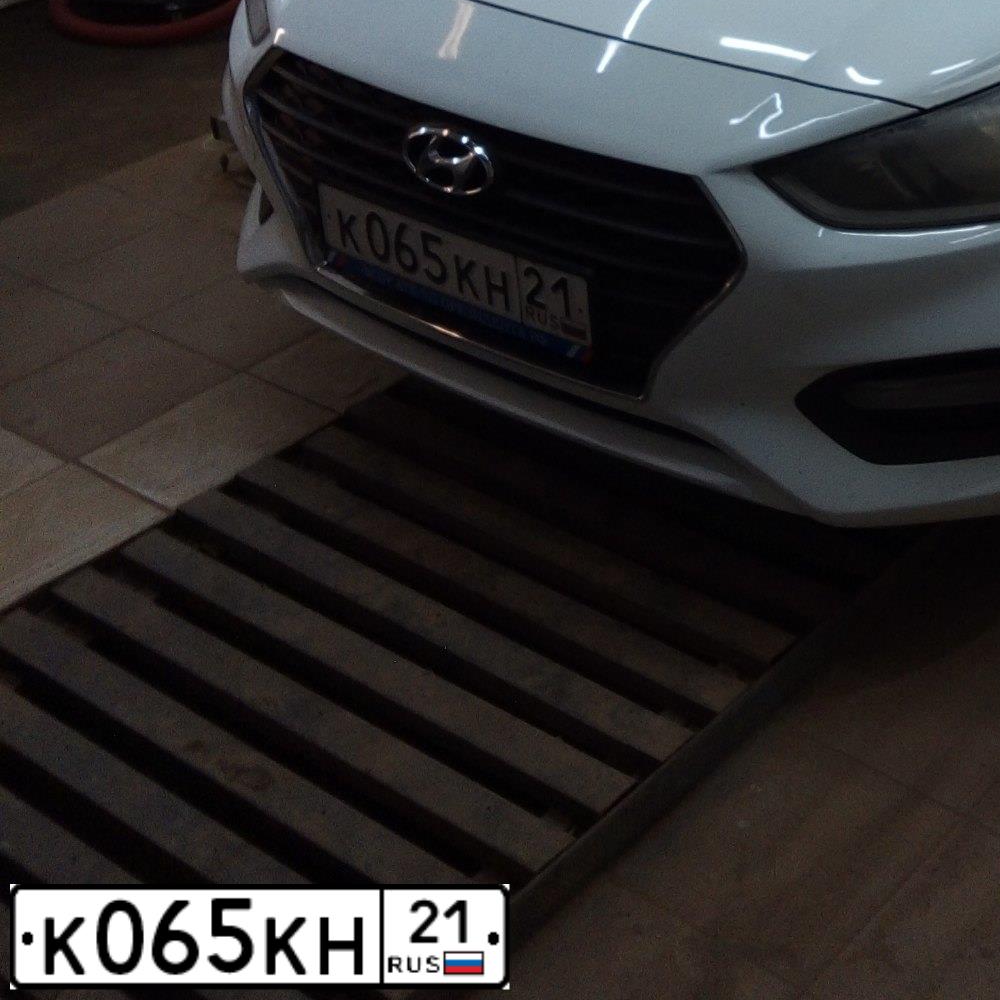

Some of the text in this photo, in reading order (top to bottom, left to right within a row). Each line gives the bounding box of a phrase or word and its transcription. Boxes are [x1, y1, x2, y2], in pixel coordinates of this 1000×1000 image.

[337, 208, 510, 312] К065КН
[522, 266, 571, 318] 21
[524, 306, 560, 330] RUS
